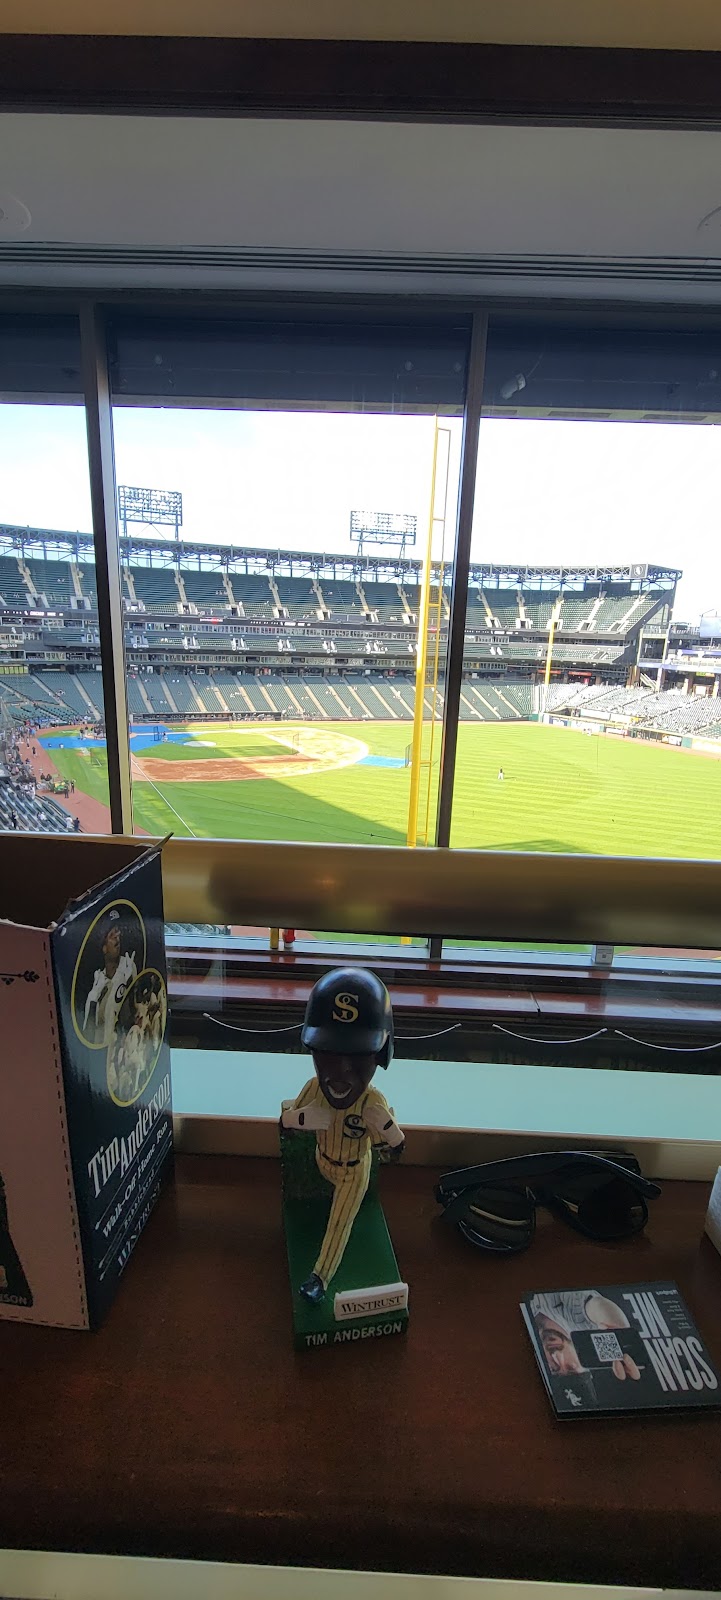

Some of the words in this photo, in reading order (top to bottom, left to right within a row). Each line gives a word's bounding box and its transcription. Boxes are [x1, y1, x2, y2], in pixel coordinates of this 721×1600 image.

[87, 1137, 120, 1198] Tim
[120, 1073, 170, 1179] Anderson
[103, 1172, 136, 1237] Walk-Off
[137, 1144, 156, 1181] Home
[156, 1121, 168, 1143] Run
[305, 1333, 328, 1347] TIM
[334, 1321, 403, 1343] ANDERSON
[623, 1293, 672, 1338] ME
[642, 1336, 718, 1391] SCAN
